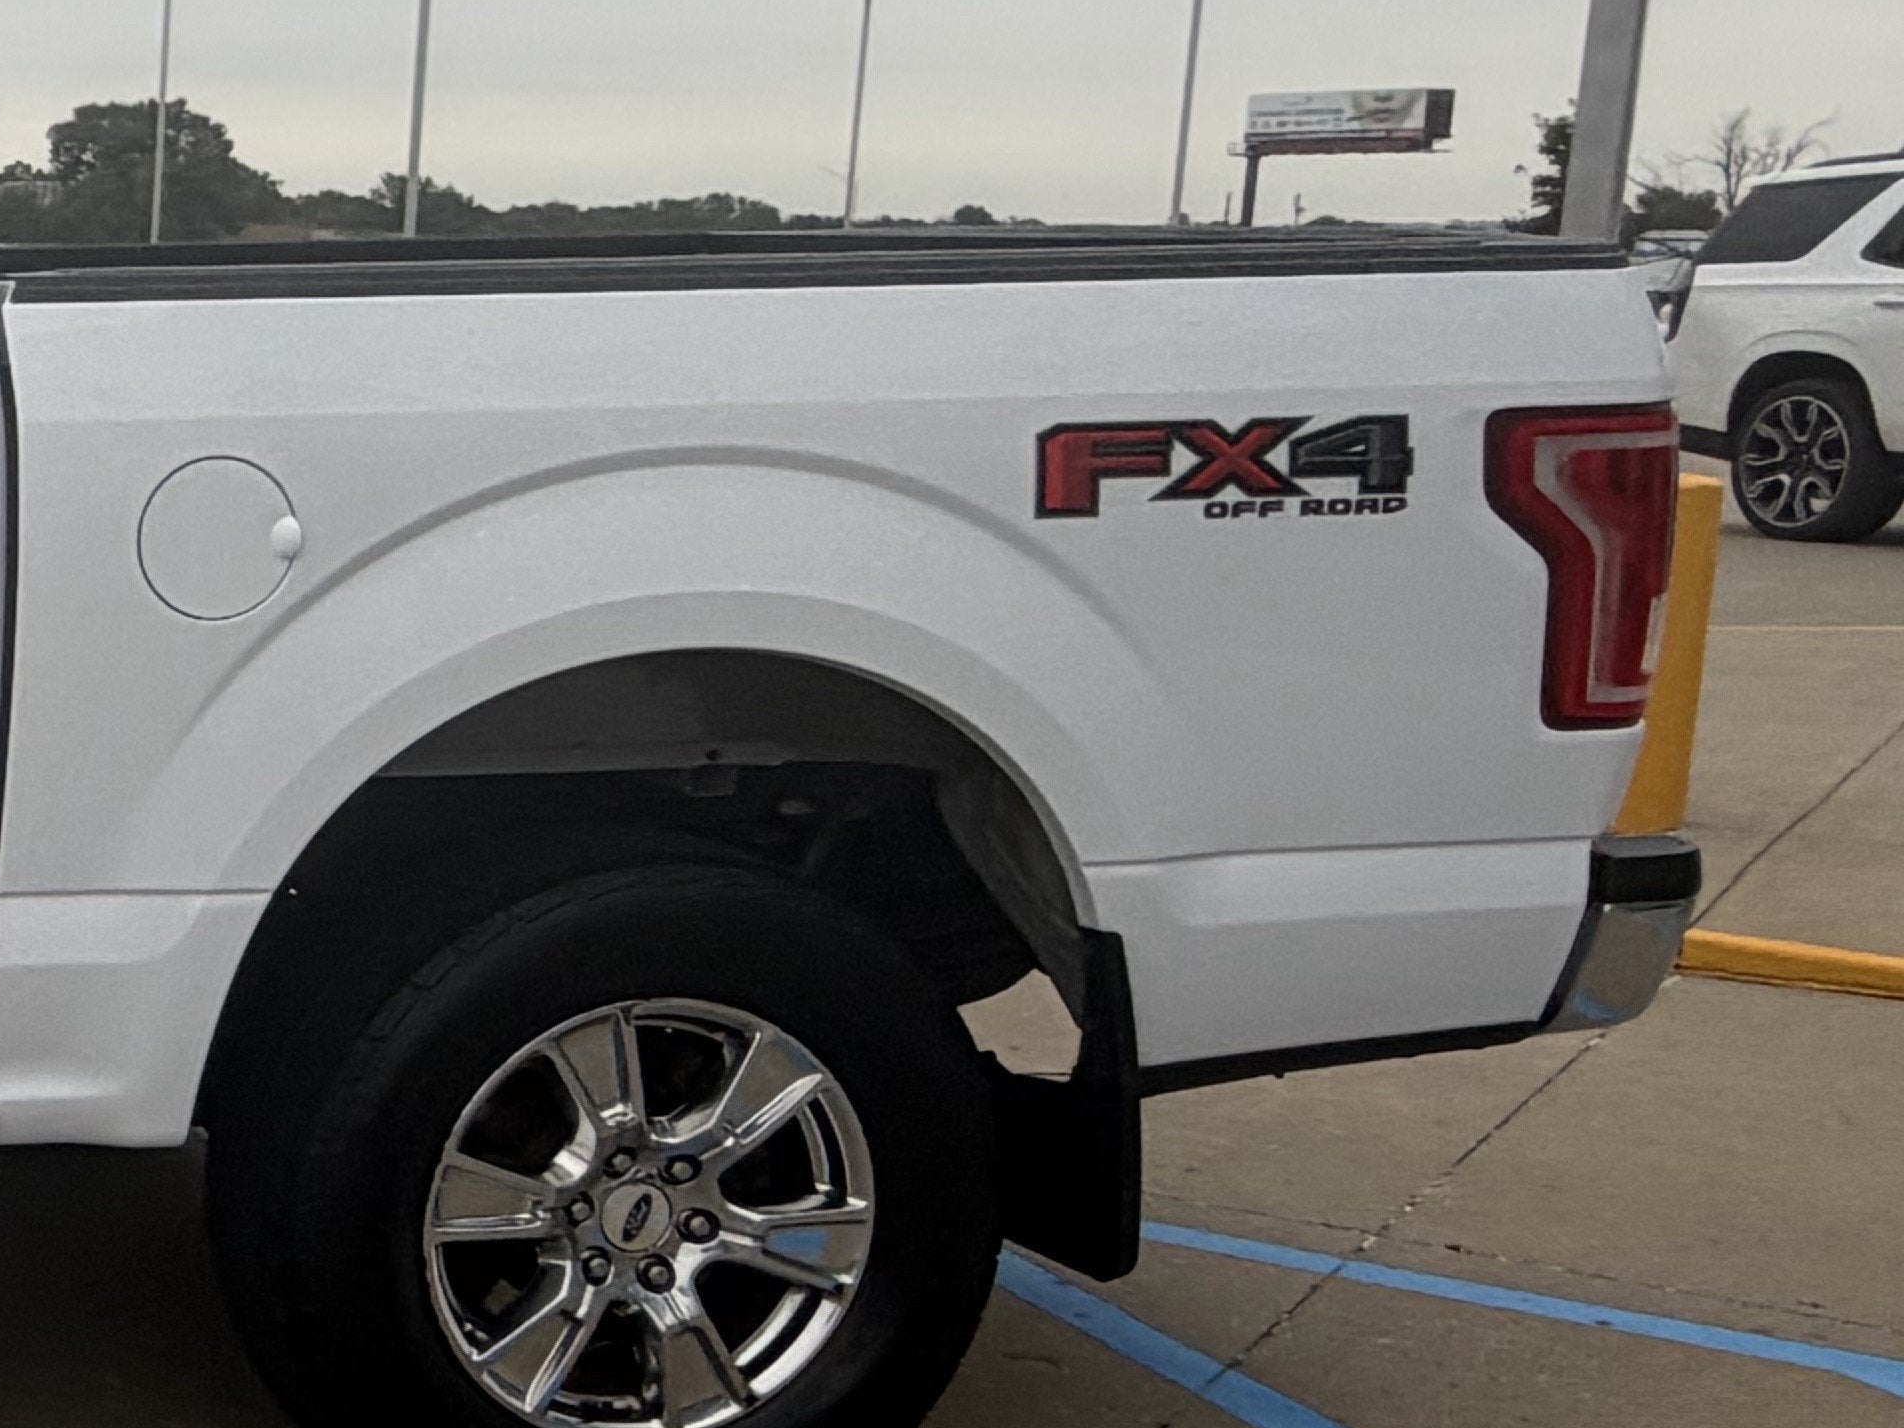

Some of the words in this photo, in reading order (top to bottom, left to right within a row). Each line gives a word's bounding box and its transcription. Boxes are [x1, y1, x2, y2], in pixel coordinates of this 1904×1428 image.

[1034, 413, 1414, 519] FX4
[1203, 501, 1286, 520] OFF
[1298, 496, 1408, 518] ROAD
